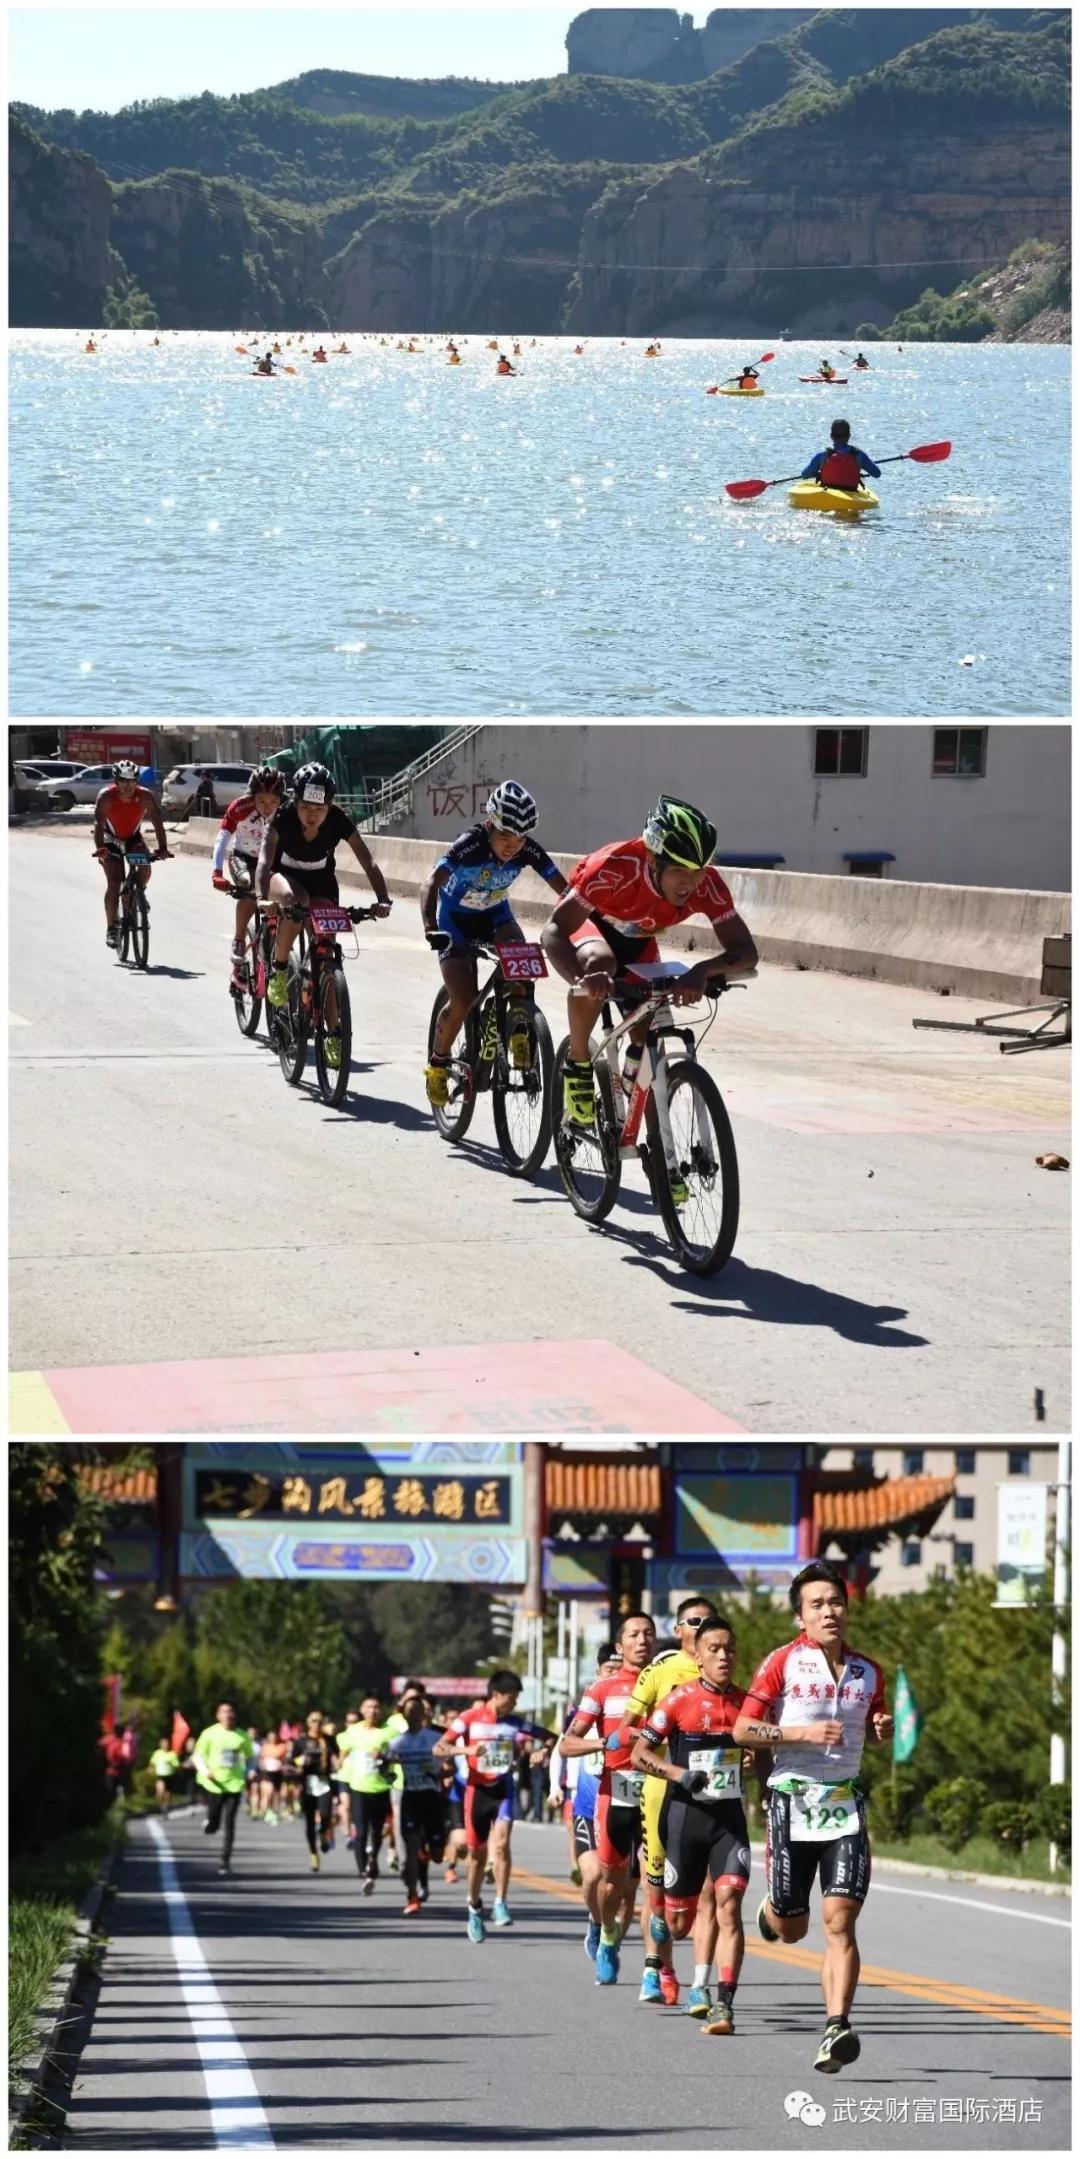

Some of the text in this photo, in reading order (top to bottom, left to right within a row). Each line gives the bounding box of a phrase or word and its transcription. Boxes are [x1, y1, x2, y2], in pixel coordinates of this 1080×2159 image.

[319, 919, 348, 930] 202
[507, 959, 543, 976] 236
[705, 1770, 736, 1790] 24
[801, 1806, 849, 1830] 129
